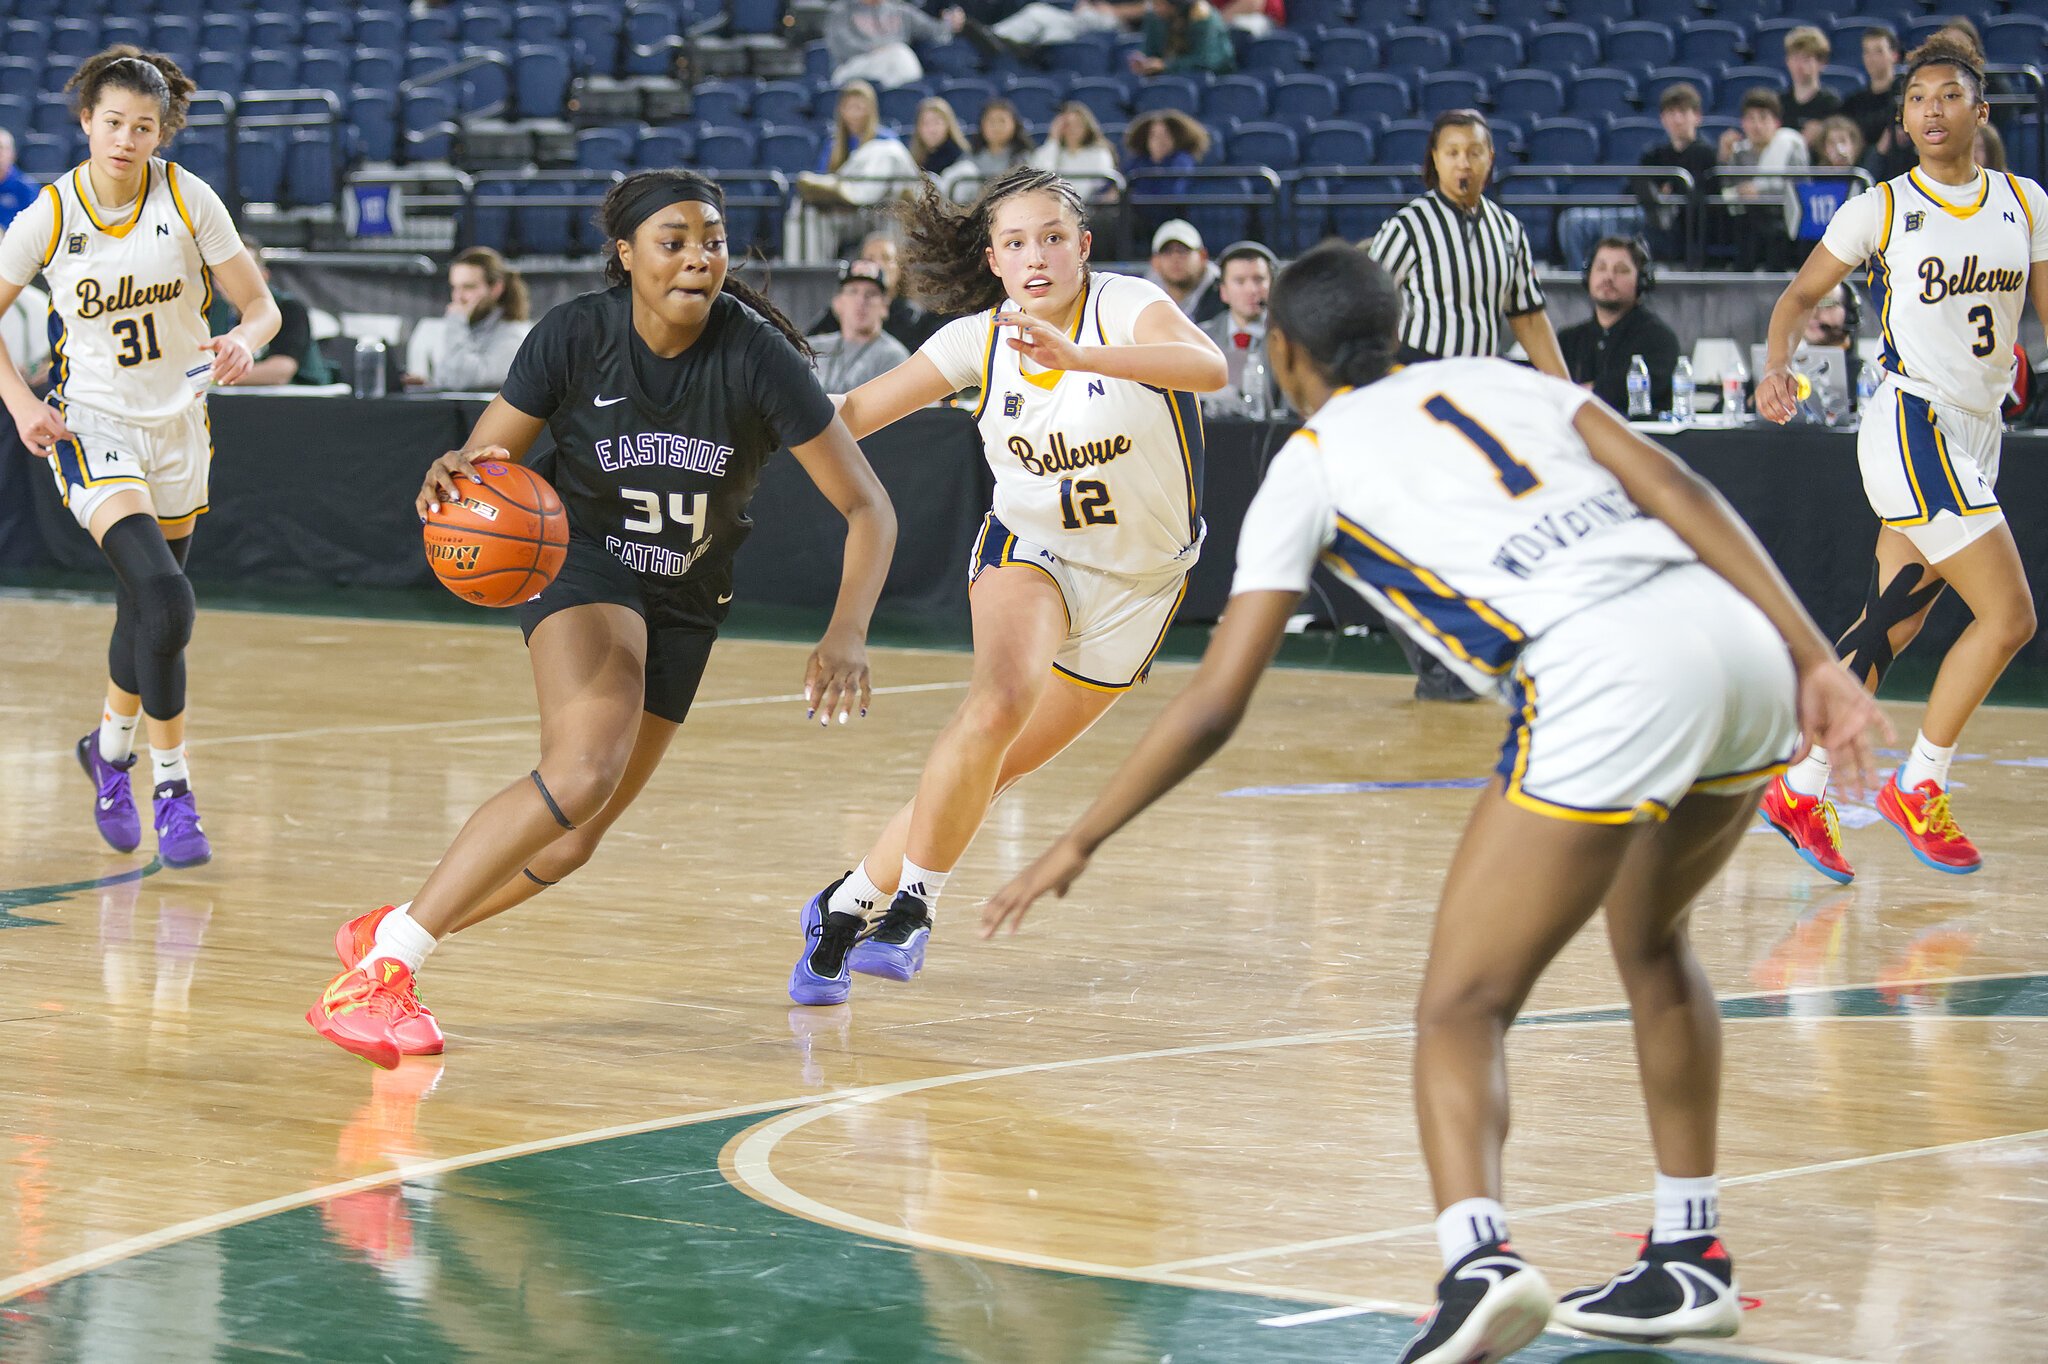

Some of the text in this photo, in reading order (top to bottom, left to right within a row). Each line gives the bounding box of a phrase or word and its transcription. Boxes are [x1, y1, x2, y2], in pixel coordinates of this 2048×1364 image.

[76, 274, 184, 319] Bellevue
[1918, 255, 2024, 305] Bellevue
[112, 311, 162, 368] 31
[1967, 303, 1996, 358] 3
[595, 432, 735, 477] EASTSIDE
[1007, 432, 1133, 477] Bellevue
[1420, 392, 1545, 500] 1
[619, 486, 709, 544] 34
[1059, 476, 1118, 530] 12
